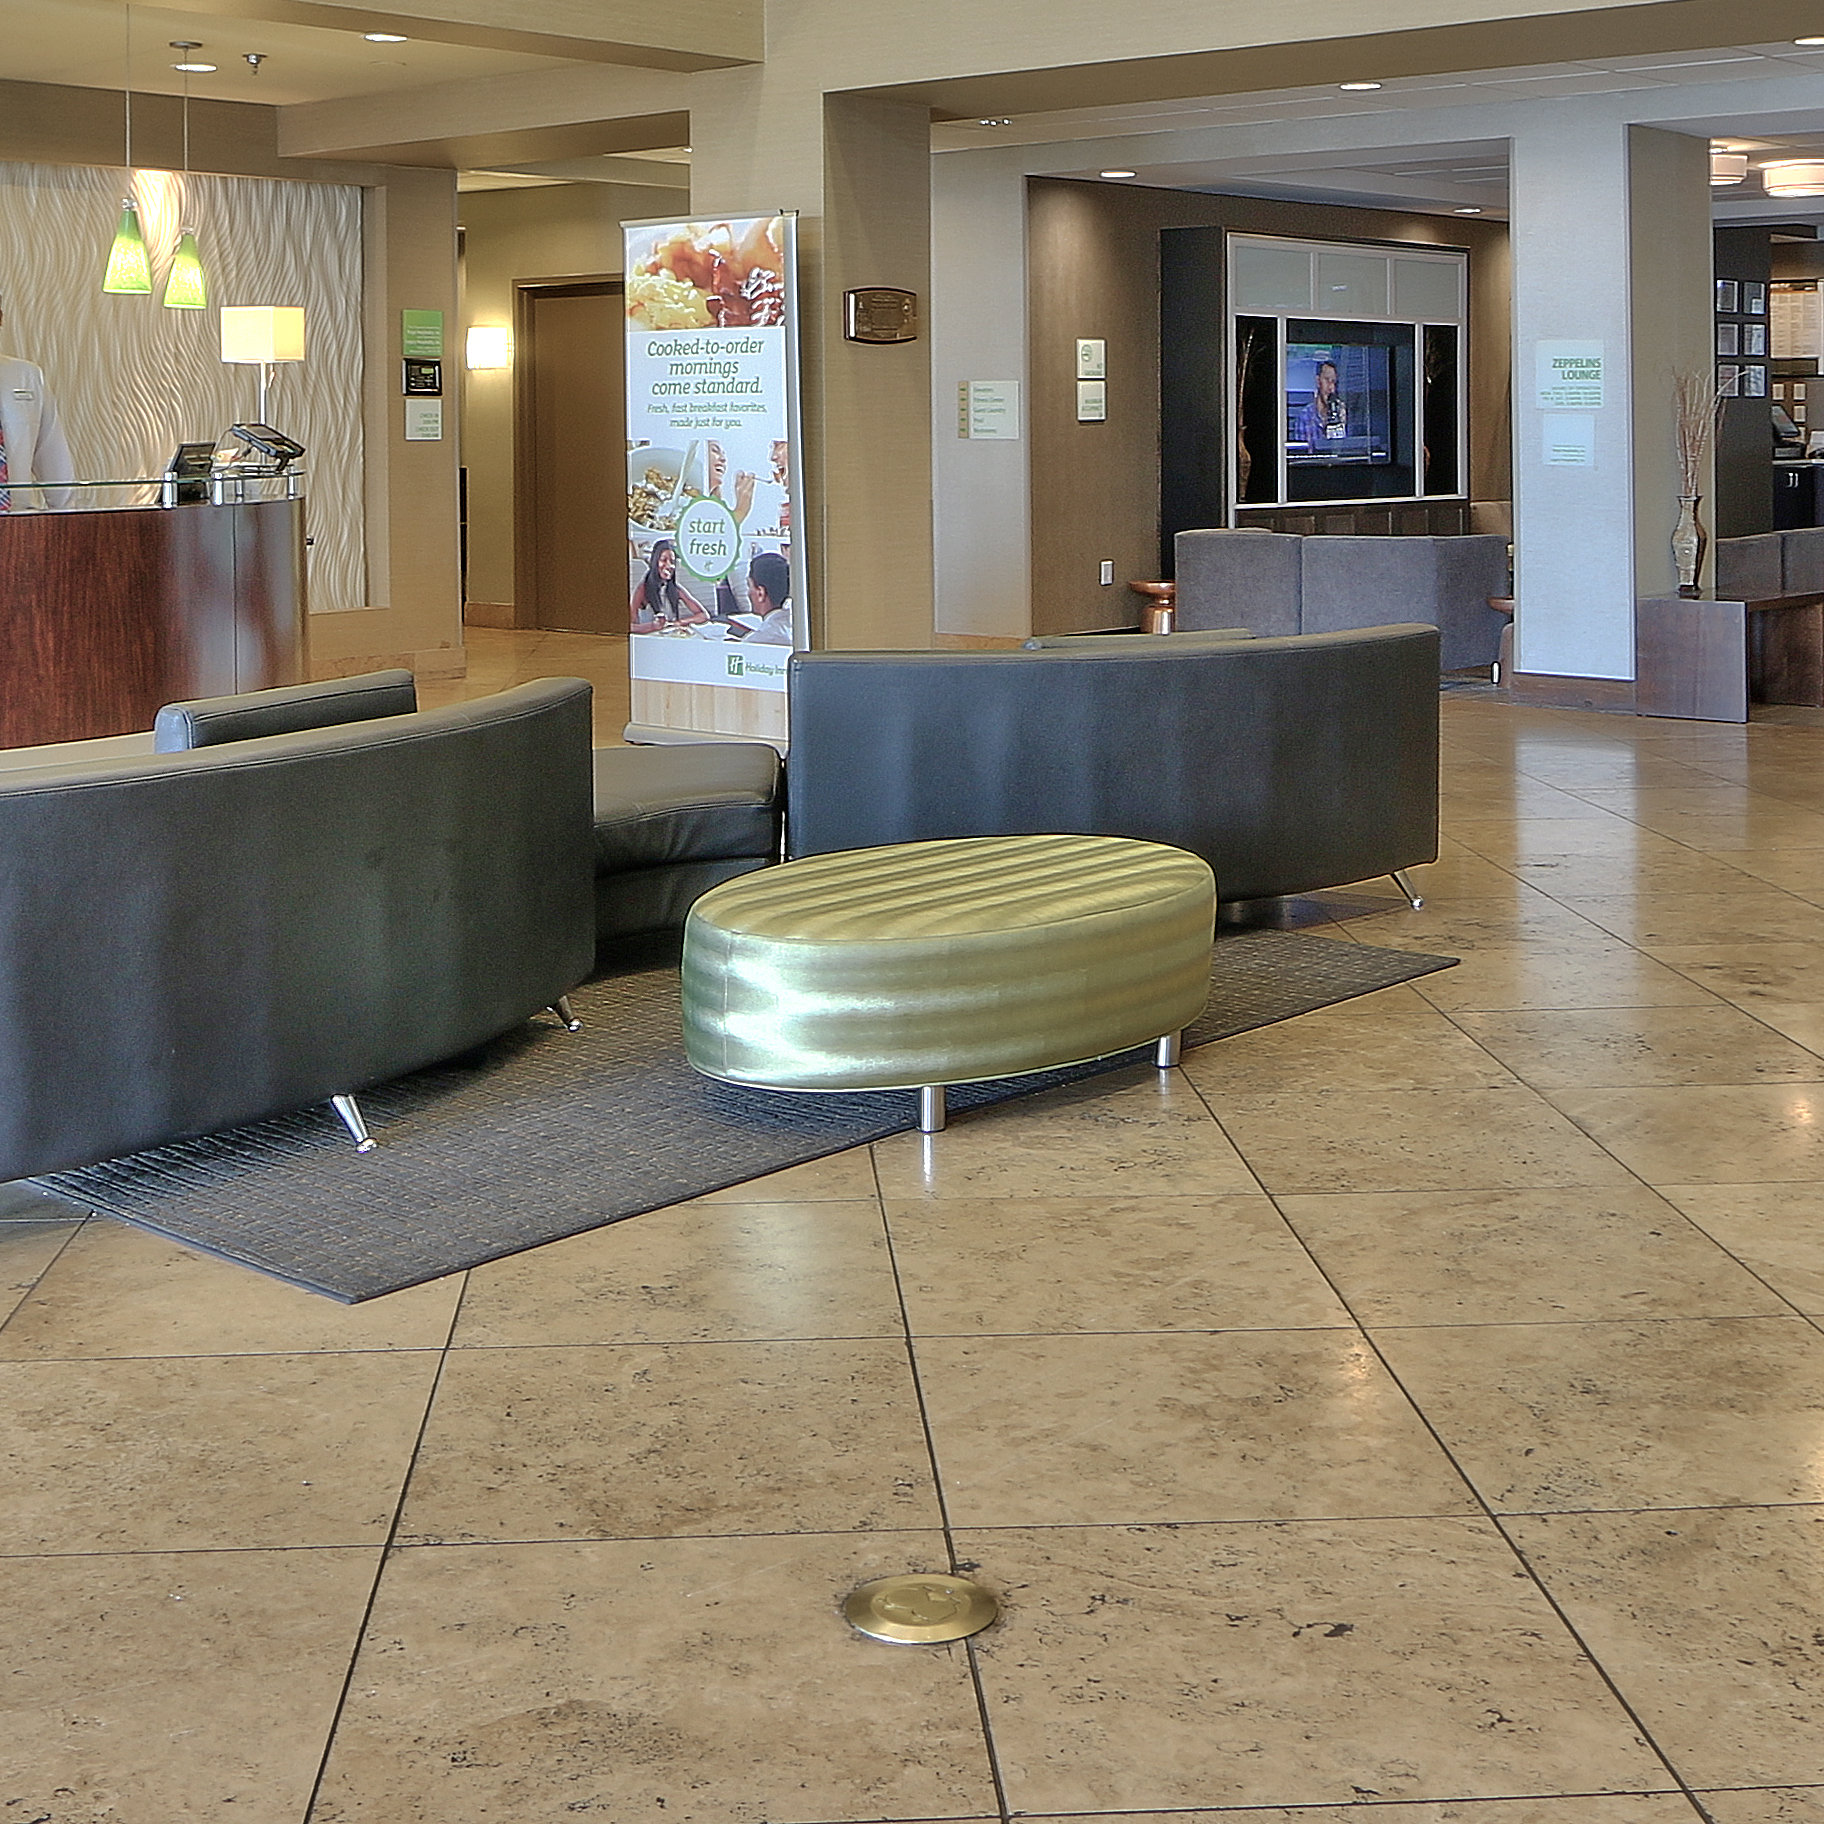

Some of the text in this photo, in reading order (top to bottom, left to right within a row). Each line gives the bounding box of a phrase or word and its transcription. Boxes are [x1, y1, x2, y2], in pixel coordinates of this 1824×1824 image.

[647, 336, 765, 357] Cooked-to-order
[669, 357, 739, 378] mornings
[1552, 357, 1601, 368] ZEPPELINS
[1562, 369, 1601, 380] LOUNGE
[651, 376, 763, 396] come standard.
[688, 401, 728, 413] breakfast
[688, 517, 725, 534] start
[689, 538, 727, 556] fresh
